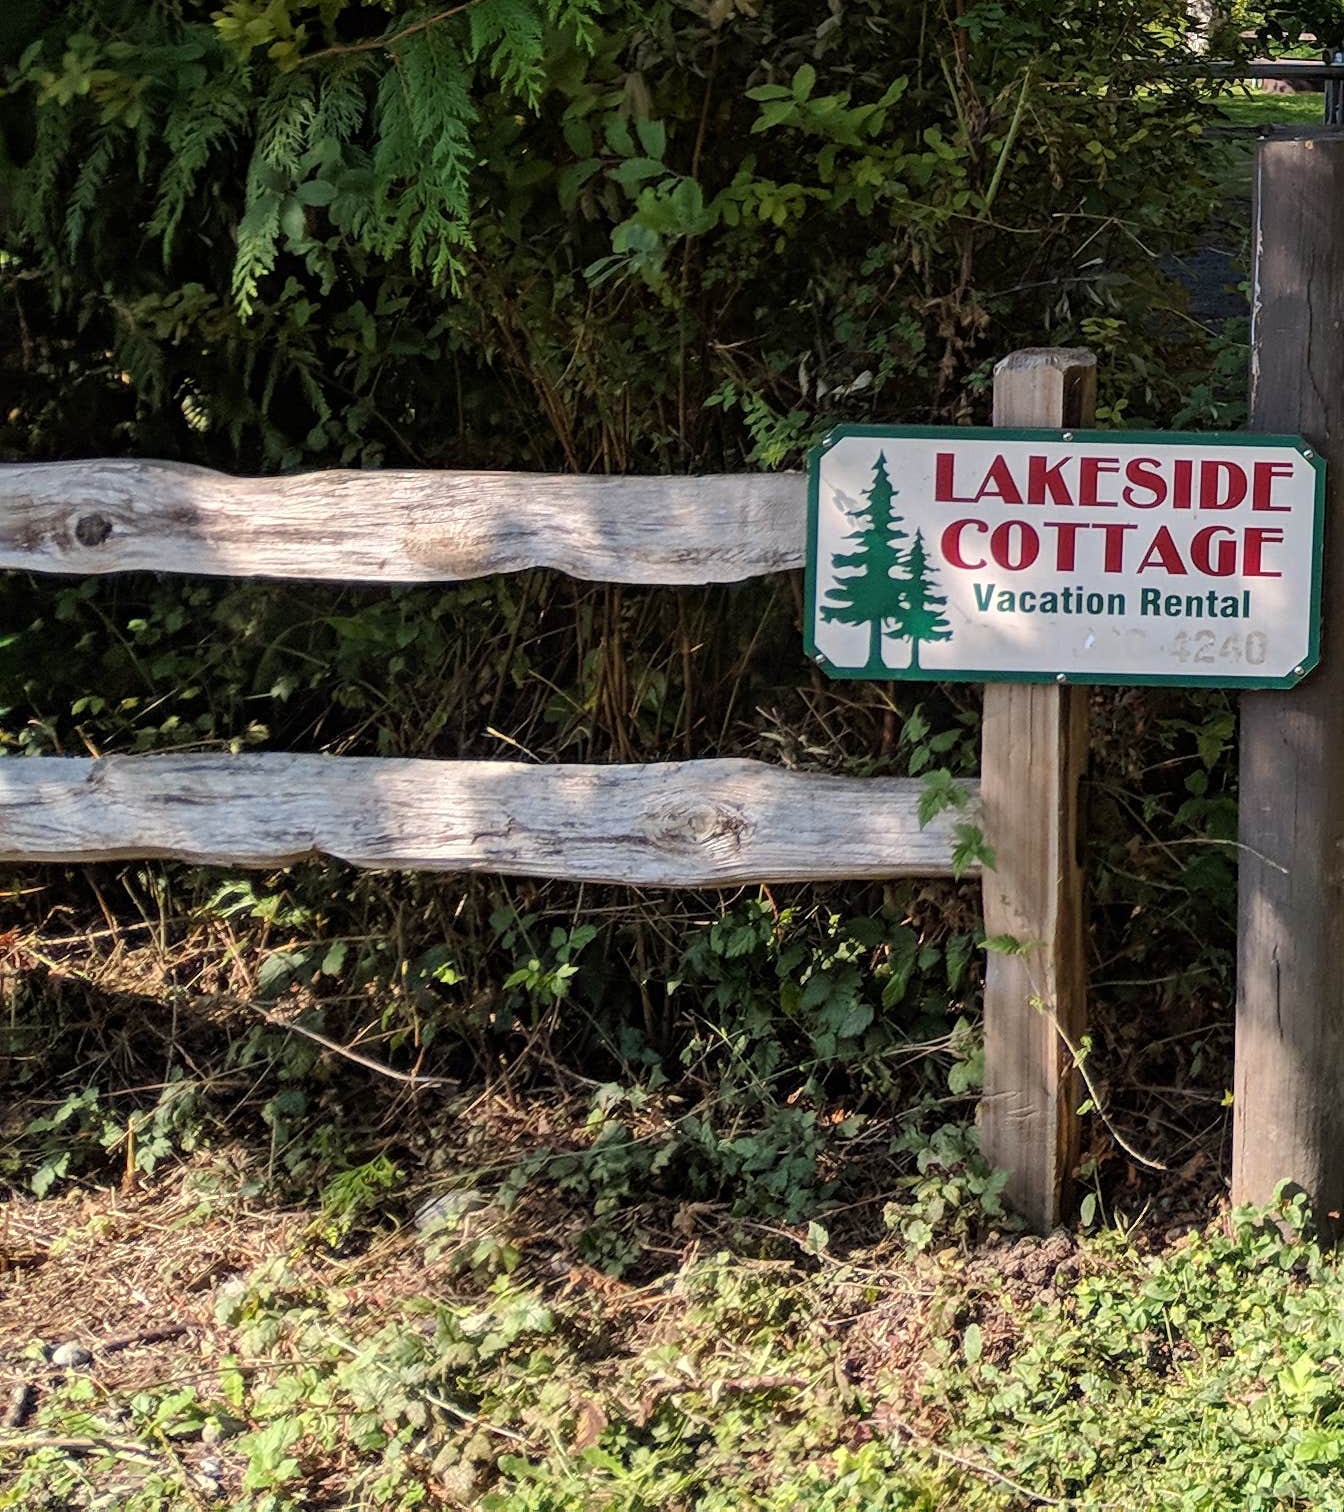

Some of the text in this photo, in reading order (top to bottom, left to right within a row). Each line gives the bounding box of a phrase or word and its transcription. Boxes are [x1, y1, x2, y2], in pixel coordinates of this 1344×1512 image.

[935, 452, 1294, 512] LAKESIDE
[940, 518, 1284, 577] COTTAGE
[973, 583, 1250, 619] Vacation Rental
